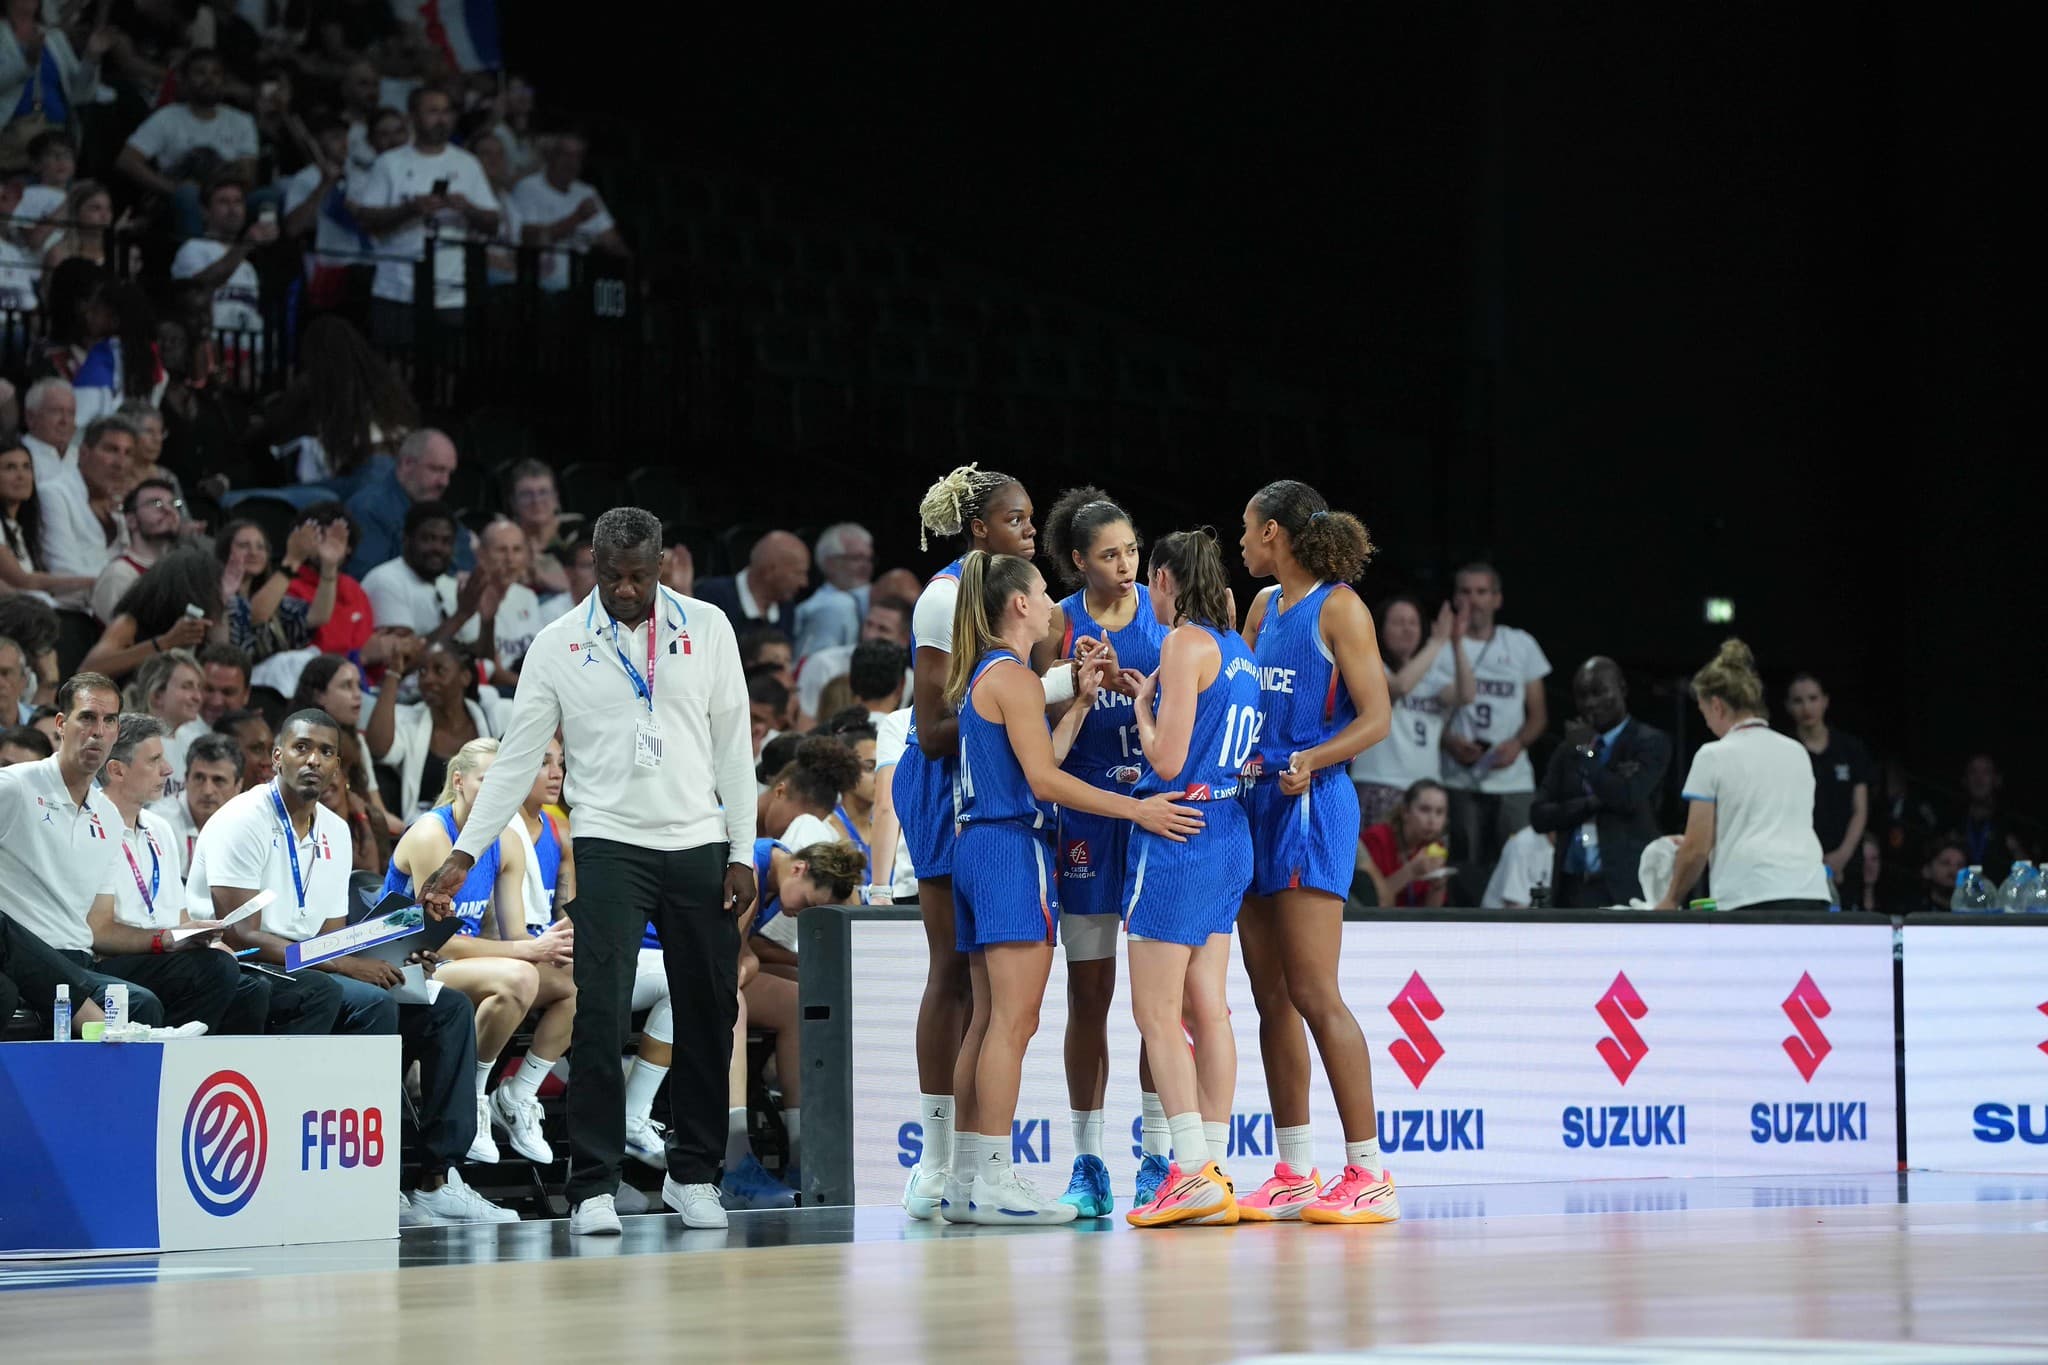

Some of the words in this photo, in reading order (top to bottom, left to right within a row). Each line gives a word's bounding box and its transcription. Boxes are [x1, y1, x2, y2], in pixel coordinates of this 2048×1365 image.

[1218, 704, 1255, 769] 10
[1252, 711, 1266, 743] 2
[302, 1107, 384, 1171] FFBB
[1376, 1108, 1485, 1154] UZUKI
[1562, 1105, 1686, 1148] SUZUKI
[1750, 1101, 1868, 1144] SUZUKI
